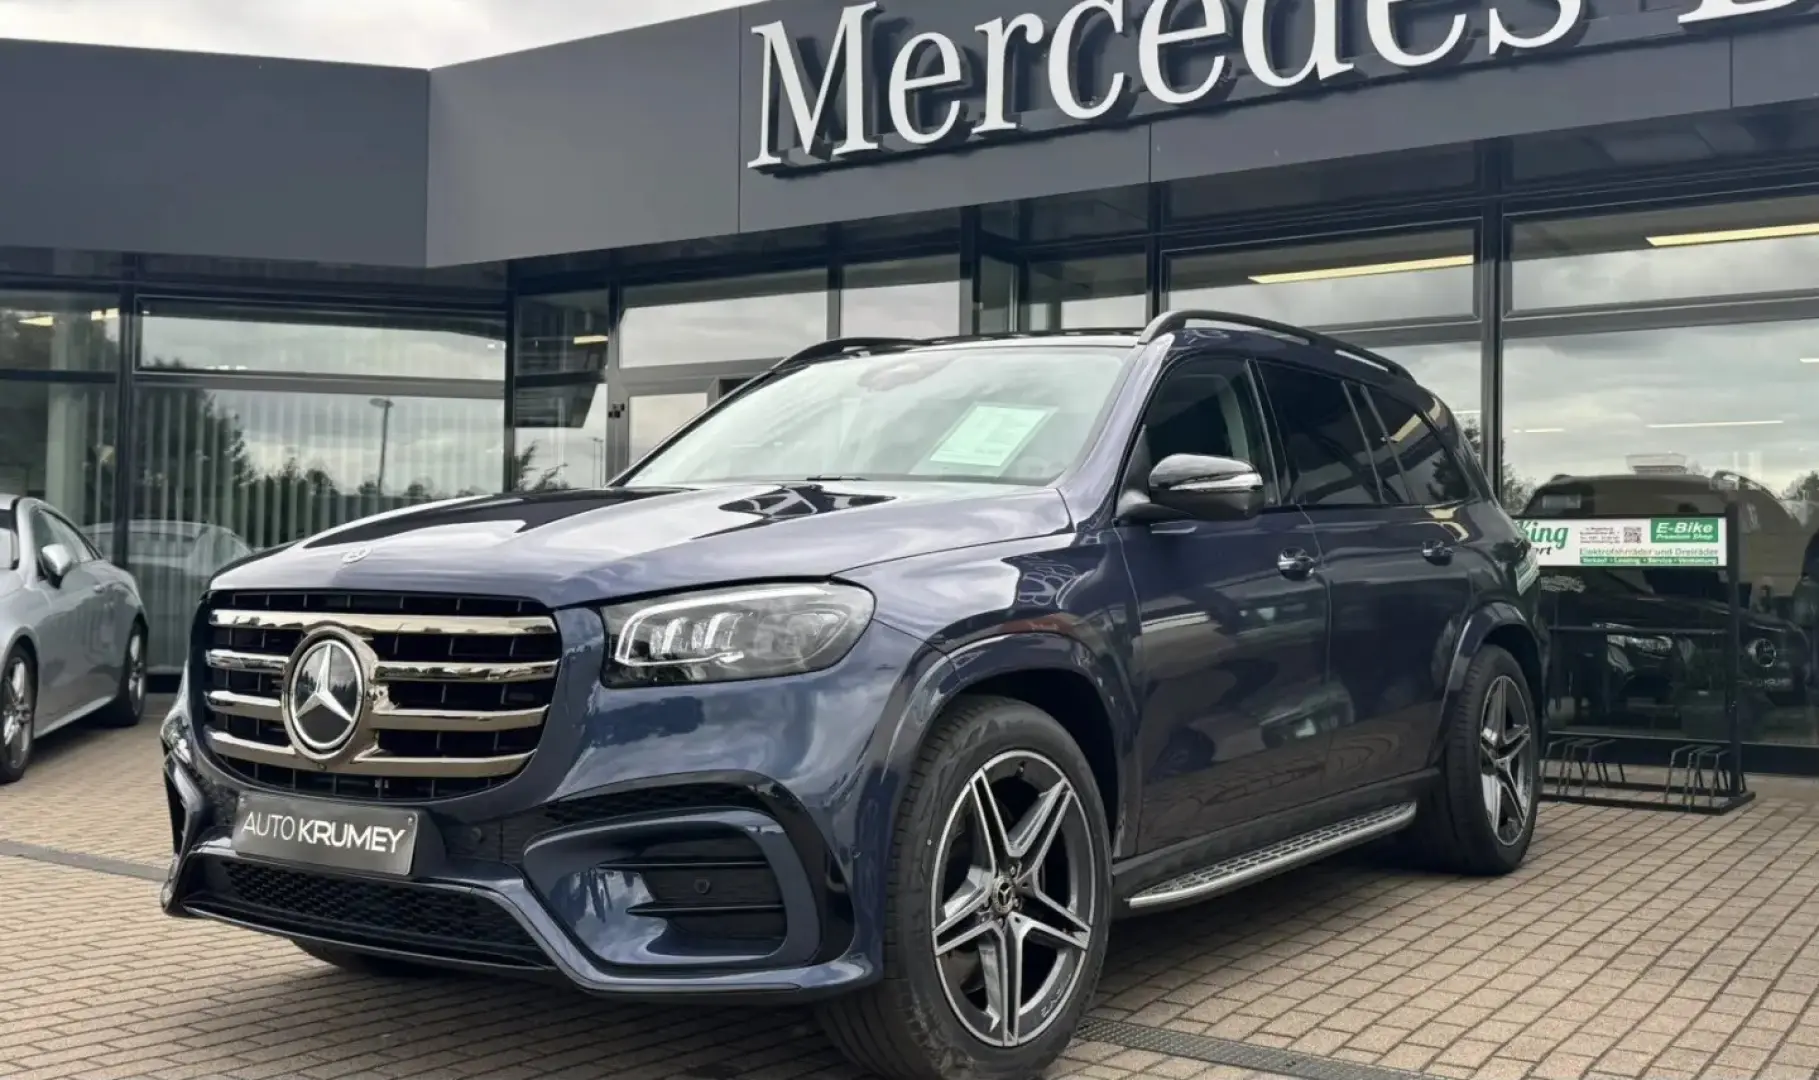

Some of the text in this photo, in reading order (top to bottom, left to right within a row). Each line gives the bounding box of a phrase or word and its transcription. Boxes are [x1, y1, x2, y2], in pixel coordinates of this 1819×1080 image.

[1656, 521, 1713, 534] E-Bike
[1656, 533, 1714, 541] Premium Shop
[1653, 547, 1674, 555] und
[241, 811, 406, 853] AUTO KRUMEY
